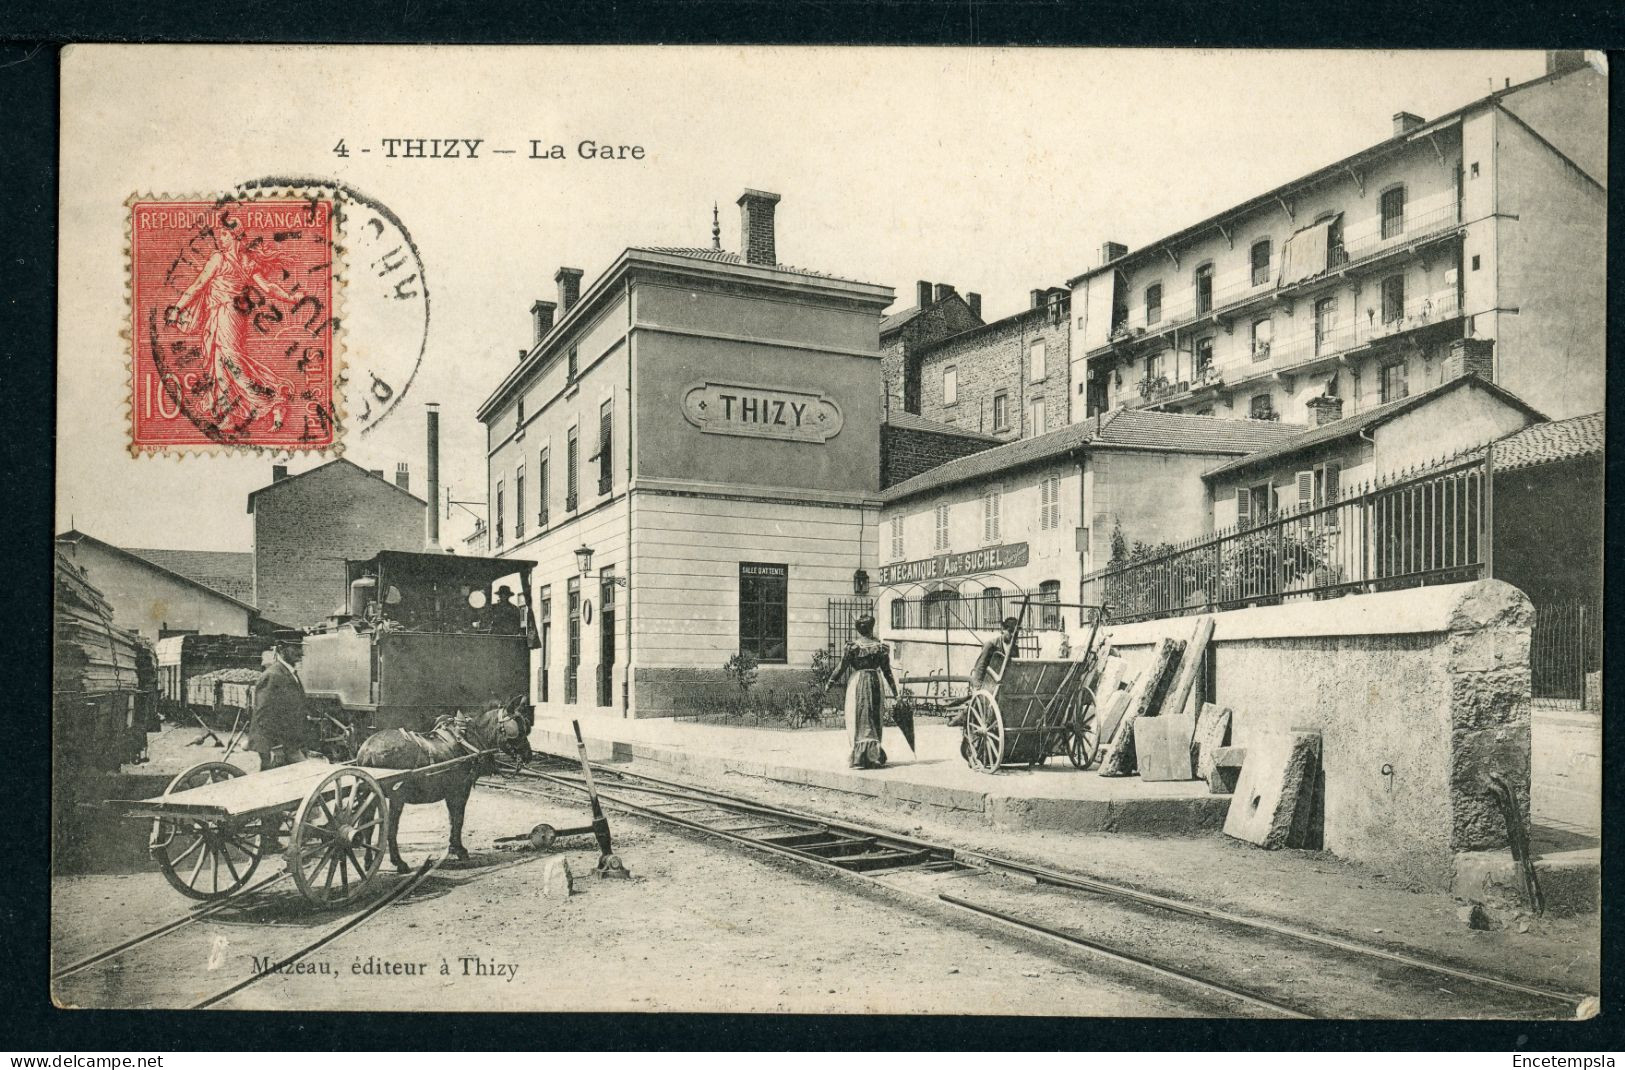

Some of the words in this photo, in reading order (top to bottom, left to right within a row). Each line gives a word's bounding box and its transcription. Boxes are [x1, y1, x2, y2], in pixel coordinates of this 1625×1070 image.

[332, 138, 350, 158] 4
[382, 138, 485, 159] THIZY
[528, 139, 566, 160] La
[577, 140, 646, 160] Gare
[304, 348, 323, 431] POSTES
[719, 394, 806, 427] THIZY
[964, 549, 1003, 571] SUCHEL
[351, 954, 428, 976] éditeur
[438, 956, 451, 976] à
[457, 956, 519, 983] Thizy
